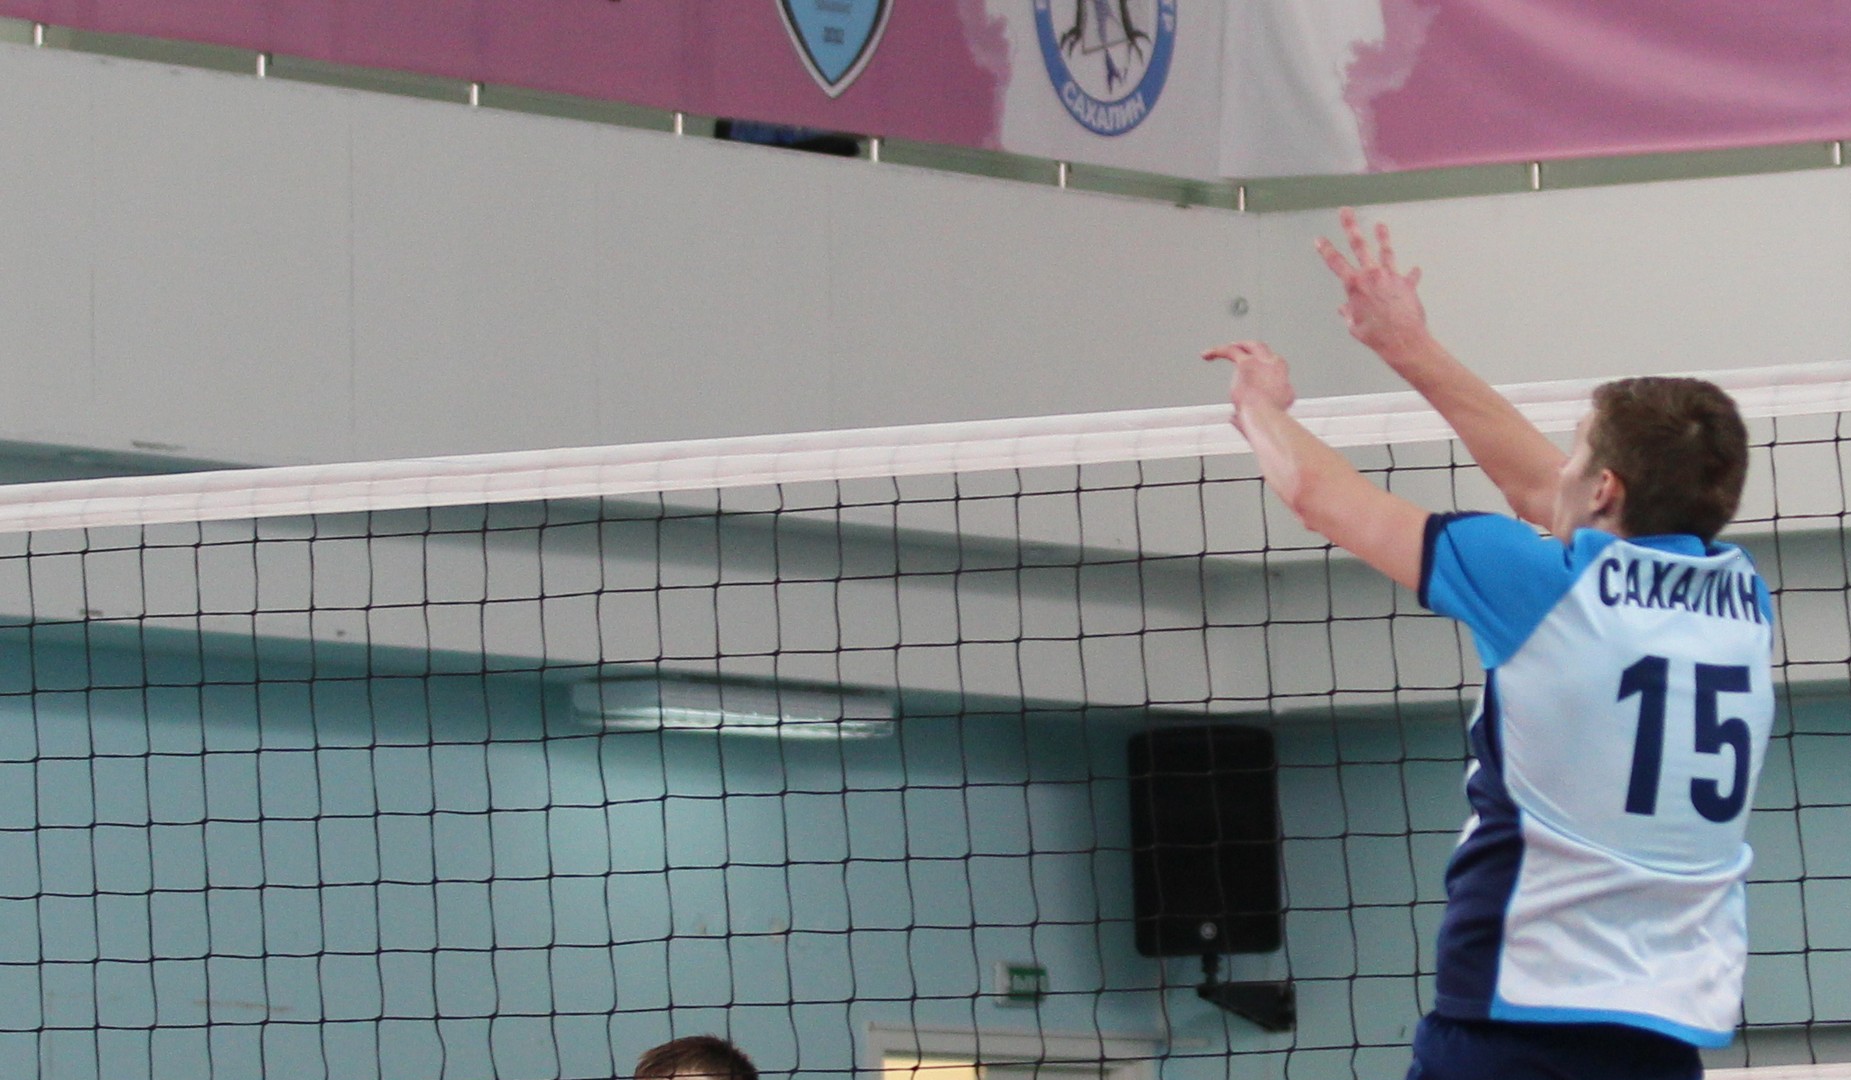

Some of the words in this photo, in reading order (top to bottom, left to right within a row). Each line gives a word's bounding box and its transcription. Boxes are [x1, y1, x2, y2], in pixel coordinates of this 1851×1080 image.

[1063, 80, 1147, 132] САХАЛИН
[1600, 557, 1763, 625] САХАЛИН
[1617, 655, 1752, 823] 15
